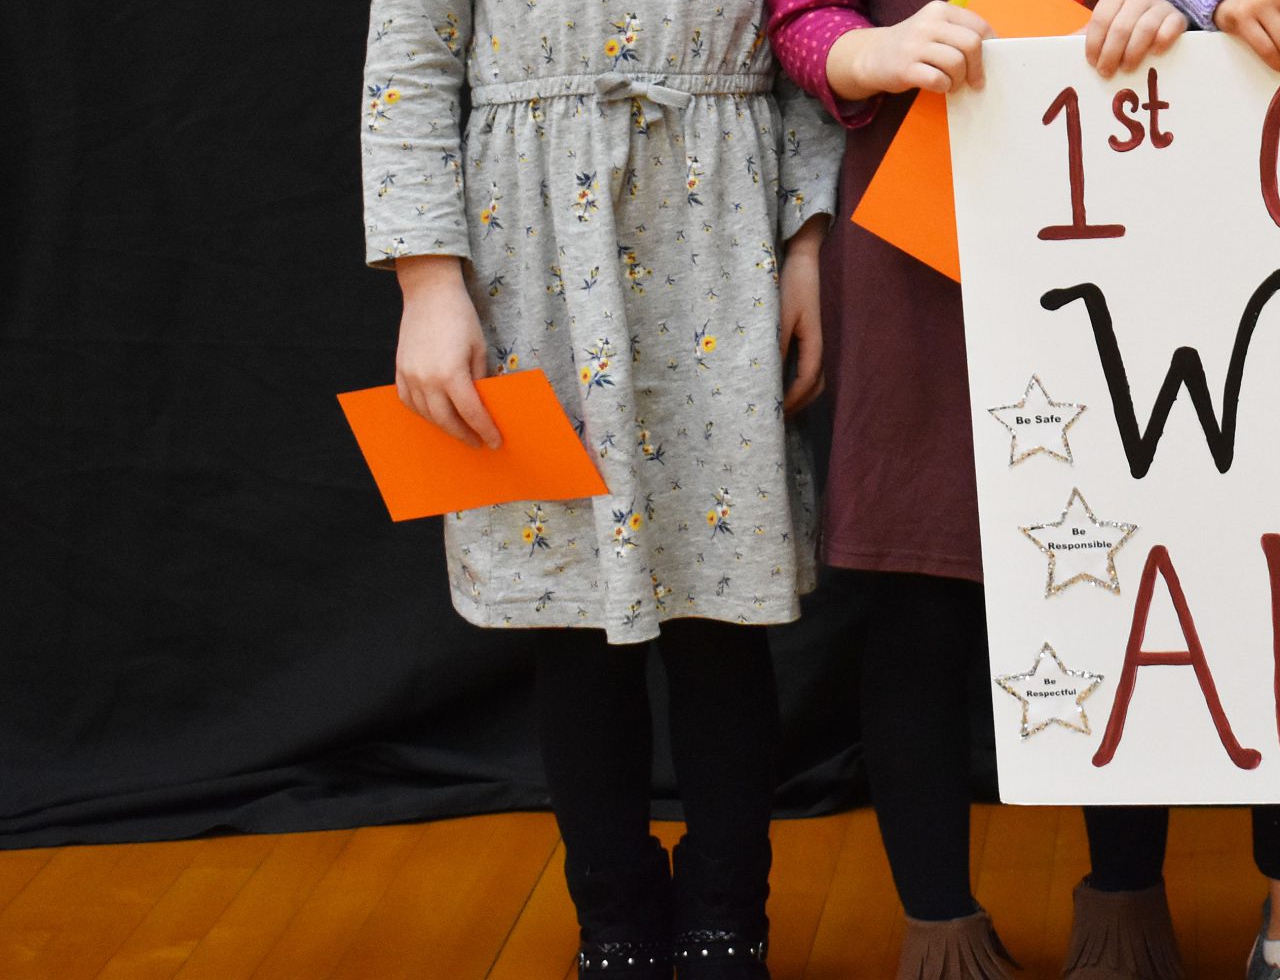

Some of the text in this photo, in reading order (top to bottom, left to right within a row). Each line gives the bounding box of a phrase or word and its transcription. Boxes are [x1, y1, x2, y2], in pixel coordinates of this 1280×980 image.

[1037, 67, 1175, 241] 1st
[1015, 414, 1061, 425] Be Safe
[1071, 527, 1086, 536] Be
[1047, 540, 1113, 551] Responsible
[1026, 688, 1077, 698] Respectful
